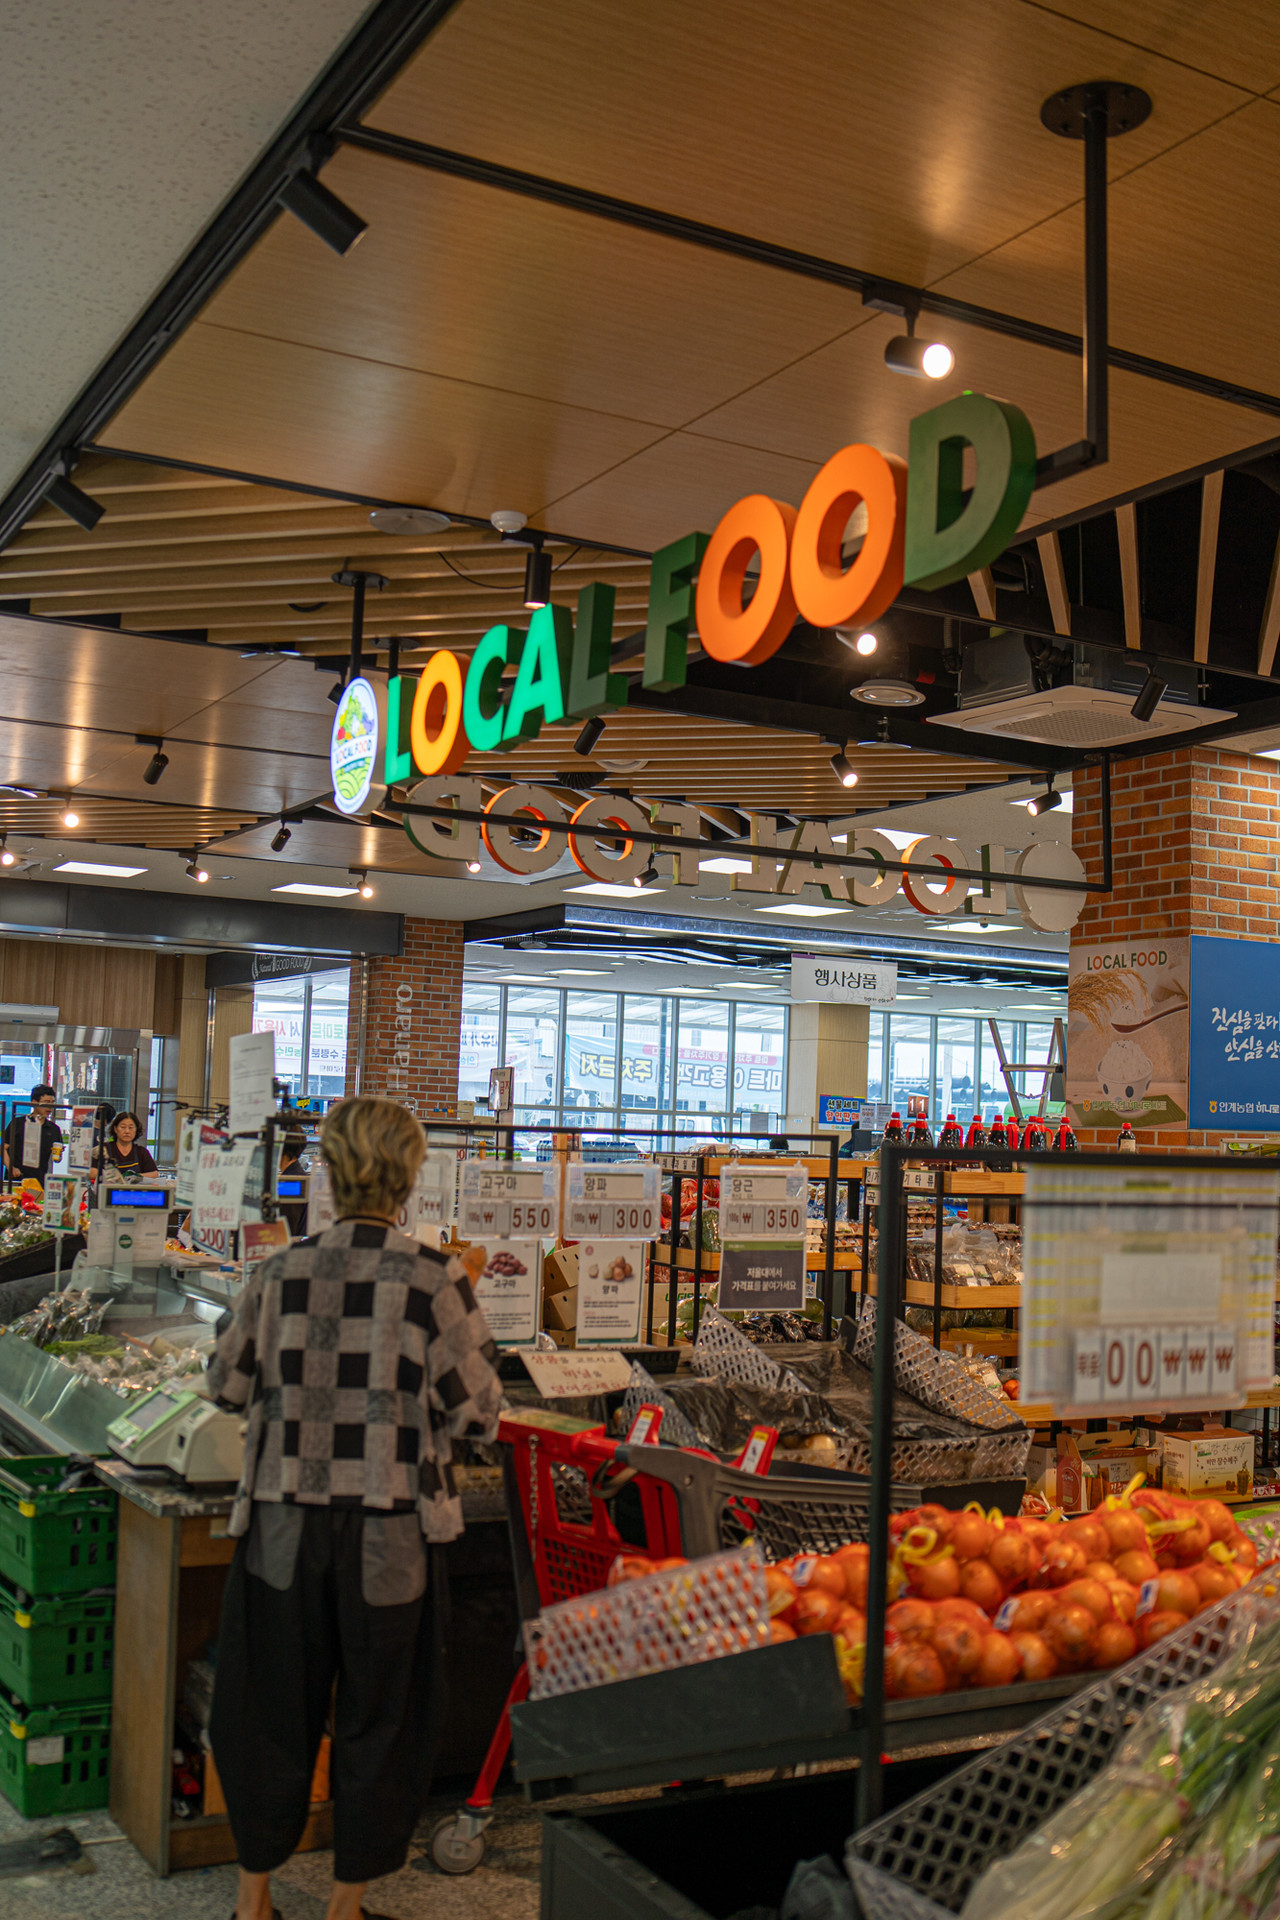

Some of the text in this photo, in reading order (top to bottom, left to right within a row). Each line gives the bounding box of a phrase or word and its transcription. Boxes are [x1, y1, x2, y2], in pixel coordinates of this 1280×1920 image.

[384, 393, 1037, 785] LOCAL FOOD
[1087, 950, 1168, 971] LOCAL FOOD
[814, 968, 877, 990] 행사상품
[1211, 1007, 1253, 1036] 진심을
[386, 984, 413, 1089] Hanaro
[1224, 1035, 1265, 1062] 안심을
[1219, 1101, 1254, 1113] 안계농협
[482, 1175, 517, 1190] 고구마
[585, 1177, 607, 1191] 양파
[732, 1179, 753, 1193] 당근
[512, 1207, 550, 1229] 550
[616, 1208, 652, 1229] 300
[767, 1208, 799, 1229] 350
